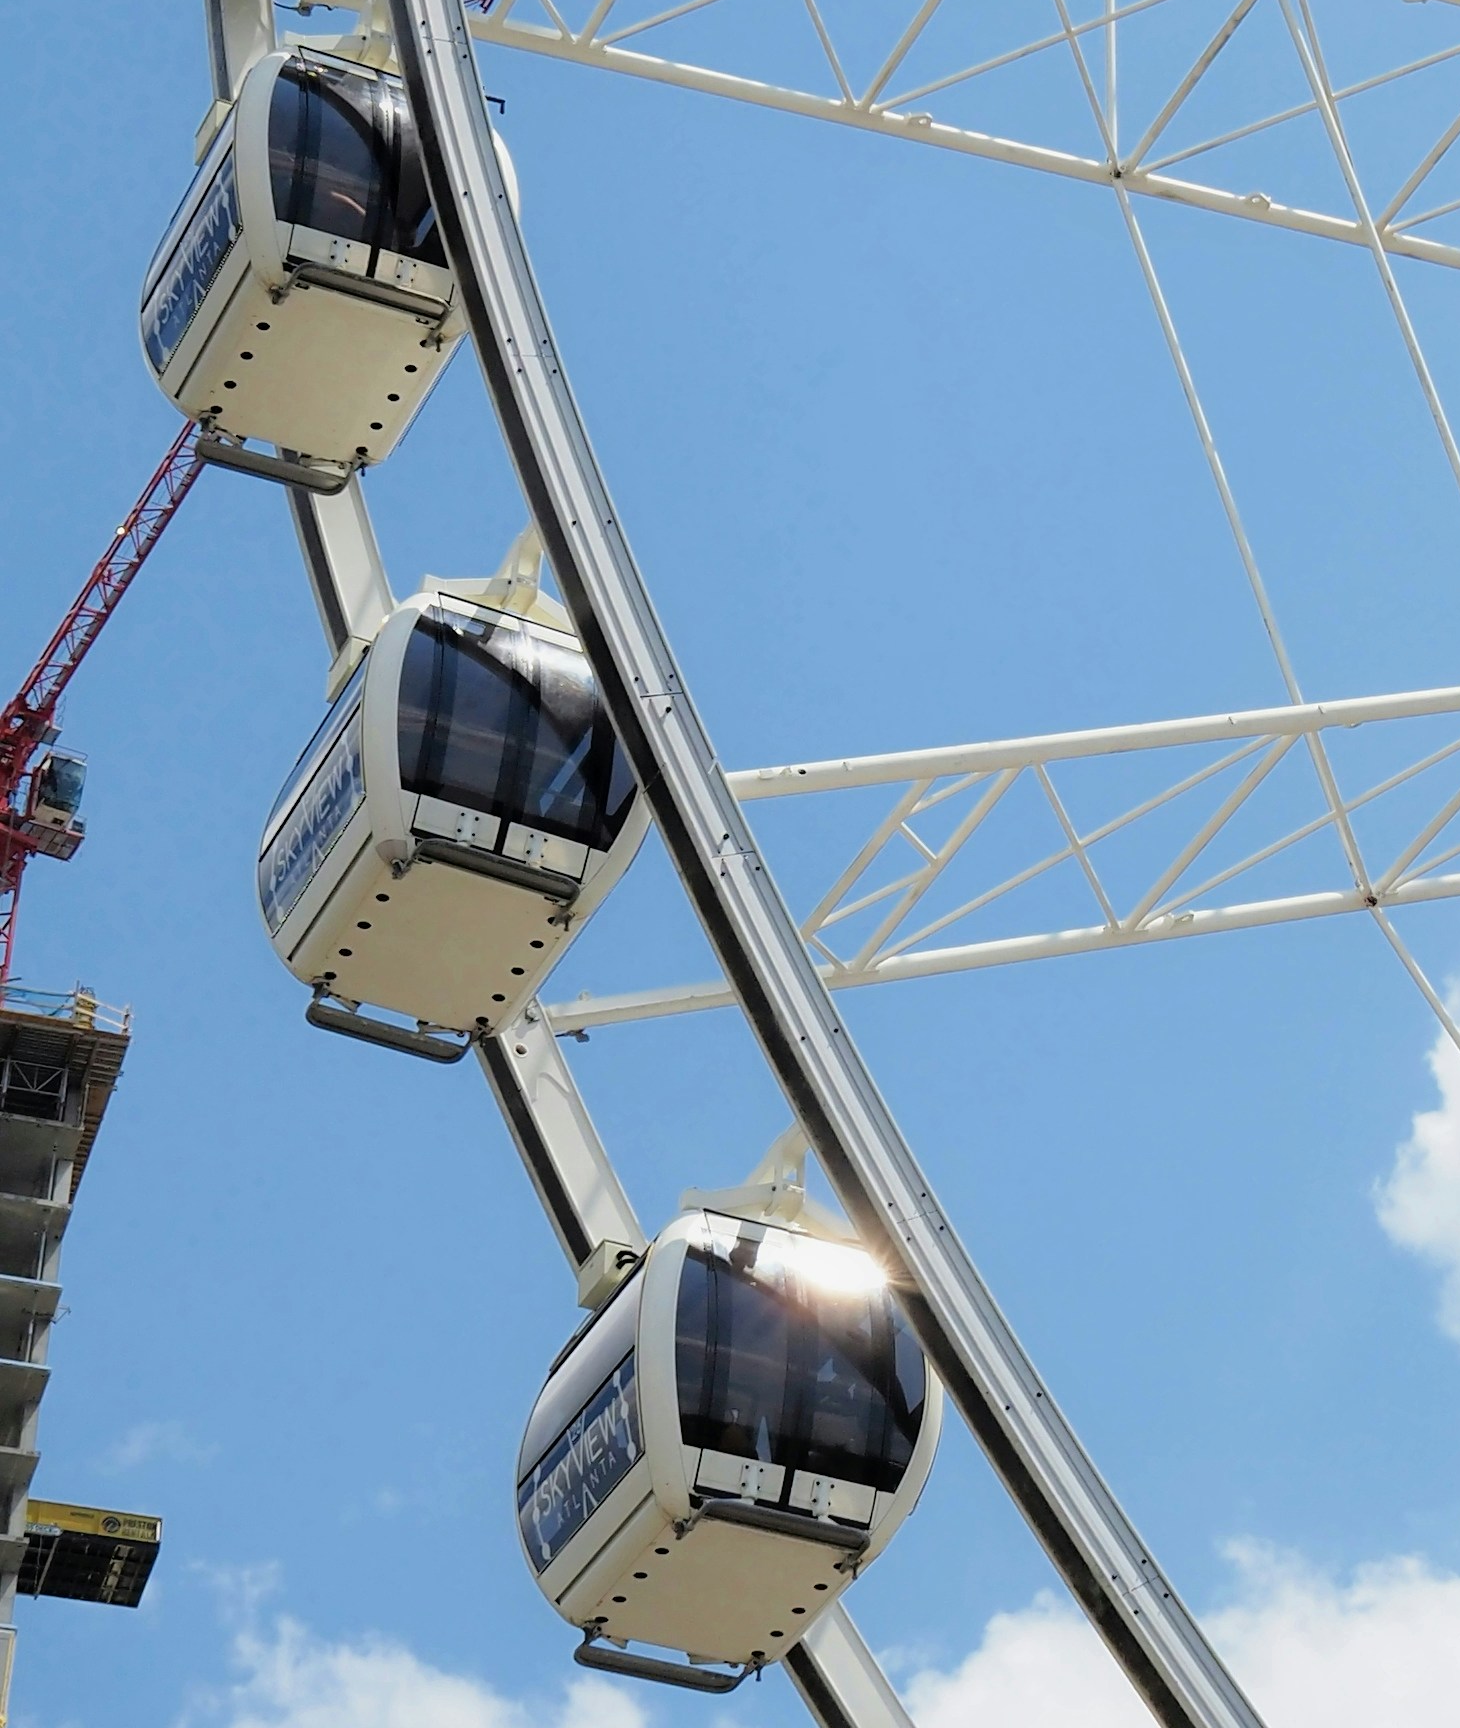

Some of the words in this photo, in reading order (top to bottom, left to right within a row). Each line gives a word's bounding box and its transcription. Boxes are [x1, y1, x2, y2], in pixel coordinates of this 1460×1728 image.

[277, 756, 344, 882] SKYVIEW
[540, 1398, 616, 1517] SKYVIEW
[557, 1451, 617, 1526] ATLANTA
